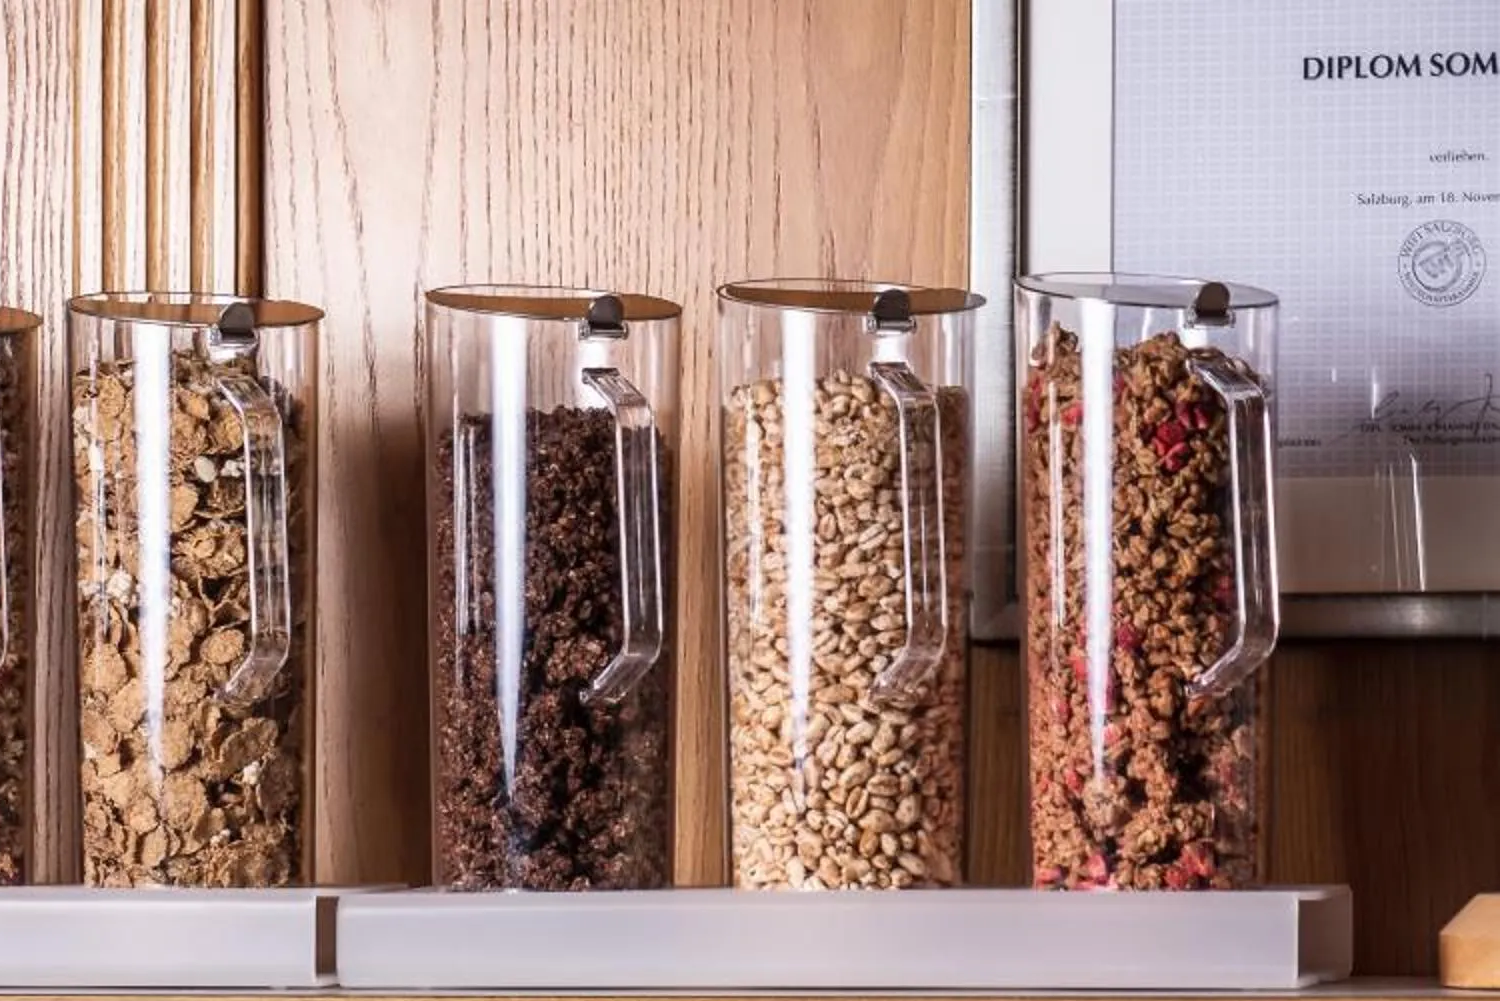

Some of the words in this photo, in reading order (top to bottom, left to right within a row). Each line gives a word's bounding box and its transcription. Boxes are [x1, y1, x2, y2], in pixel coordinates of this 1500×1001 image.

[1303, 53, 1422, 80] DIPLOM
[1429, 51, 1500, 77] SOM
[1416, 194, 1435, 205] am
